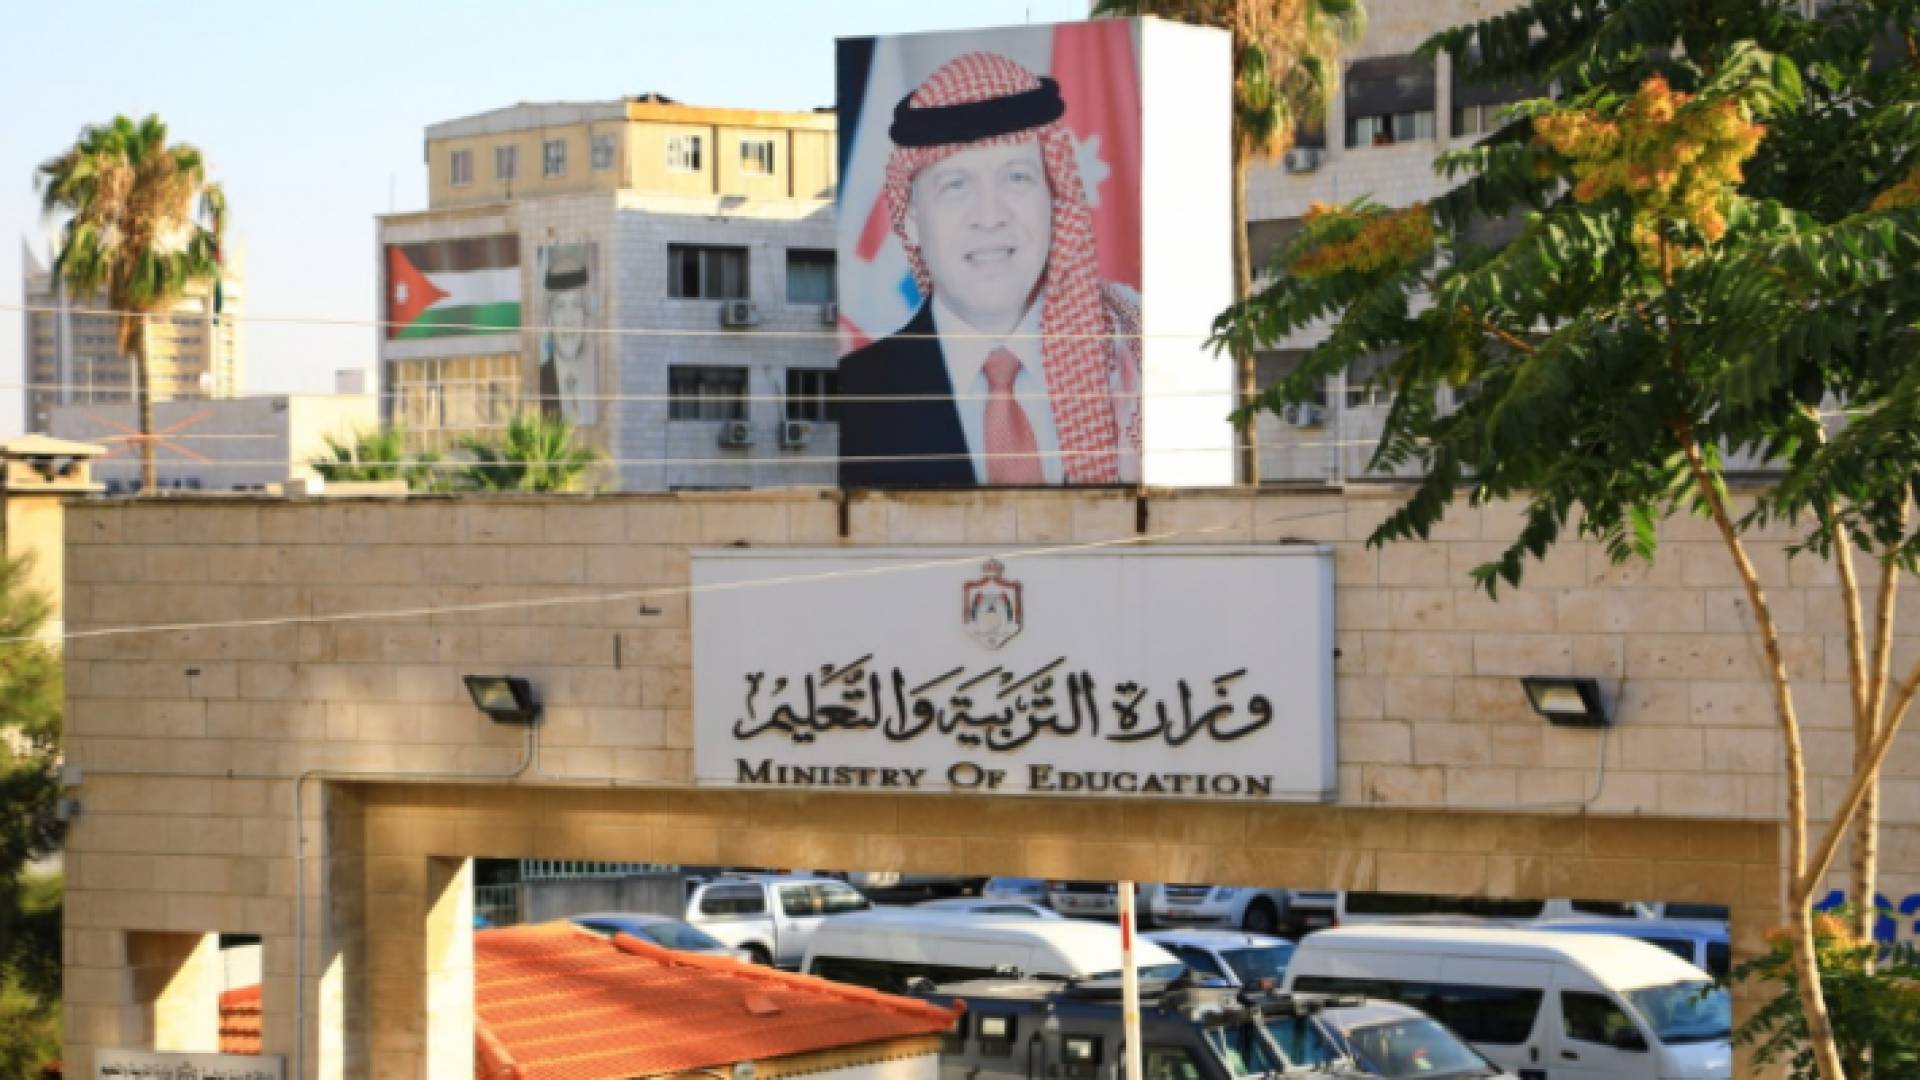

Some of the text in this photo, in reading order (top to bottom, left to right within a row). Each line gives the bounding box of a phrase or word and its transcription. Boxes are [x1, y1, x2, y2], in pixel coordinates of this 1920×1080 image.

[1104, 667, 1273, 746] وزارة
[735, 758, 1275, 796] MINISTRY OF EDUCATION
